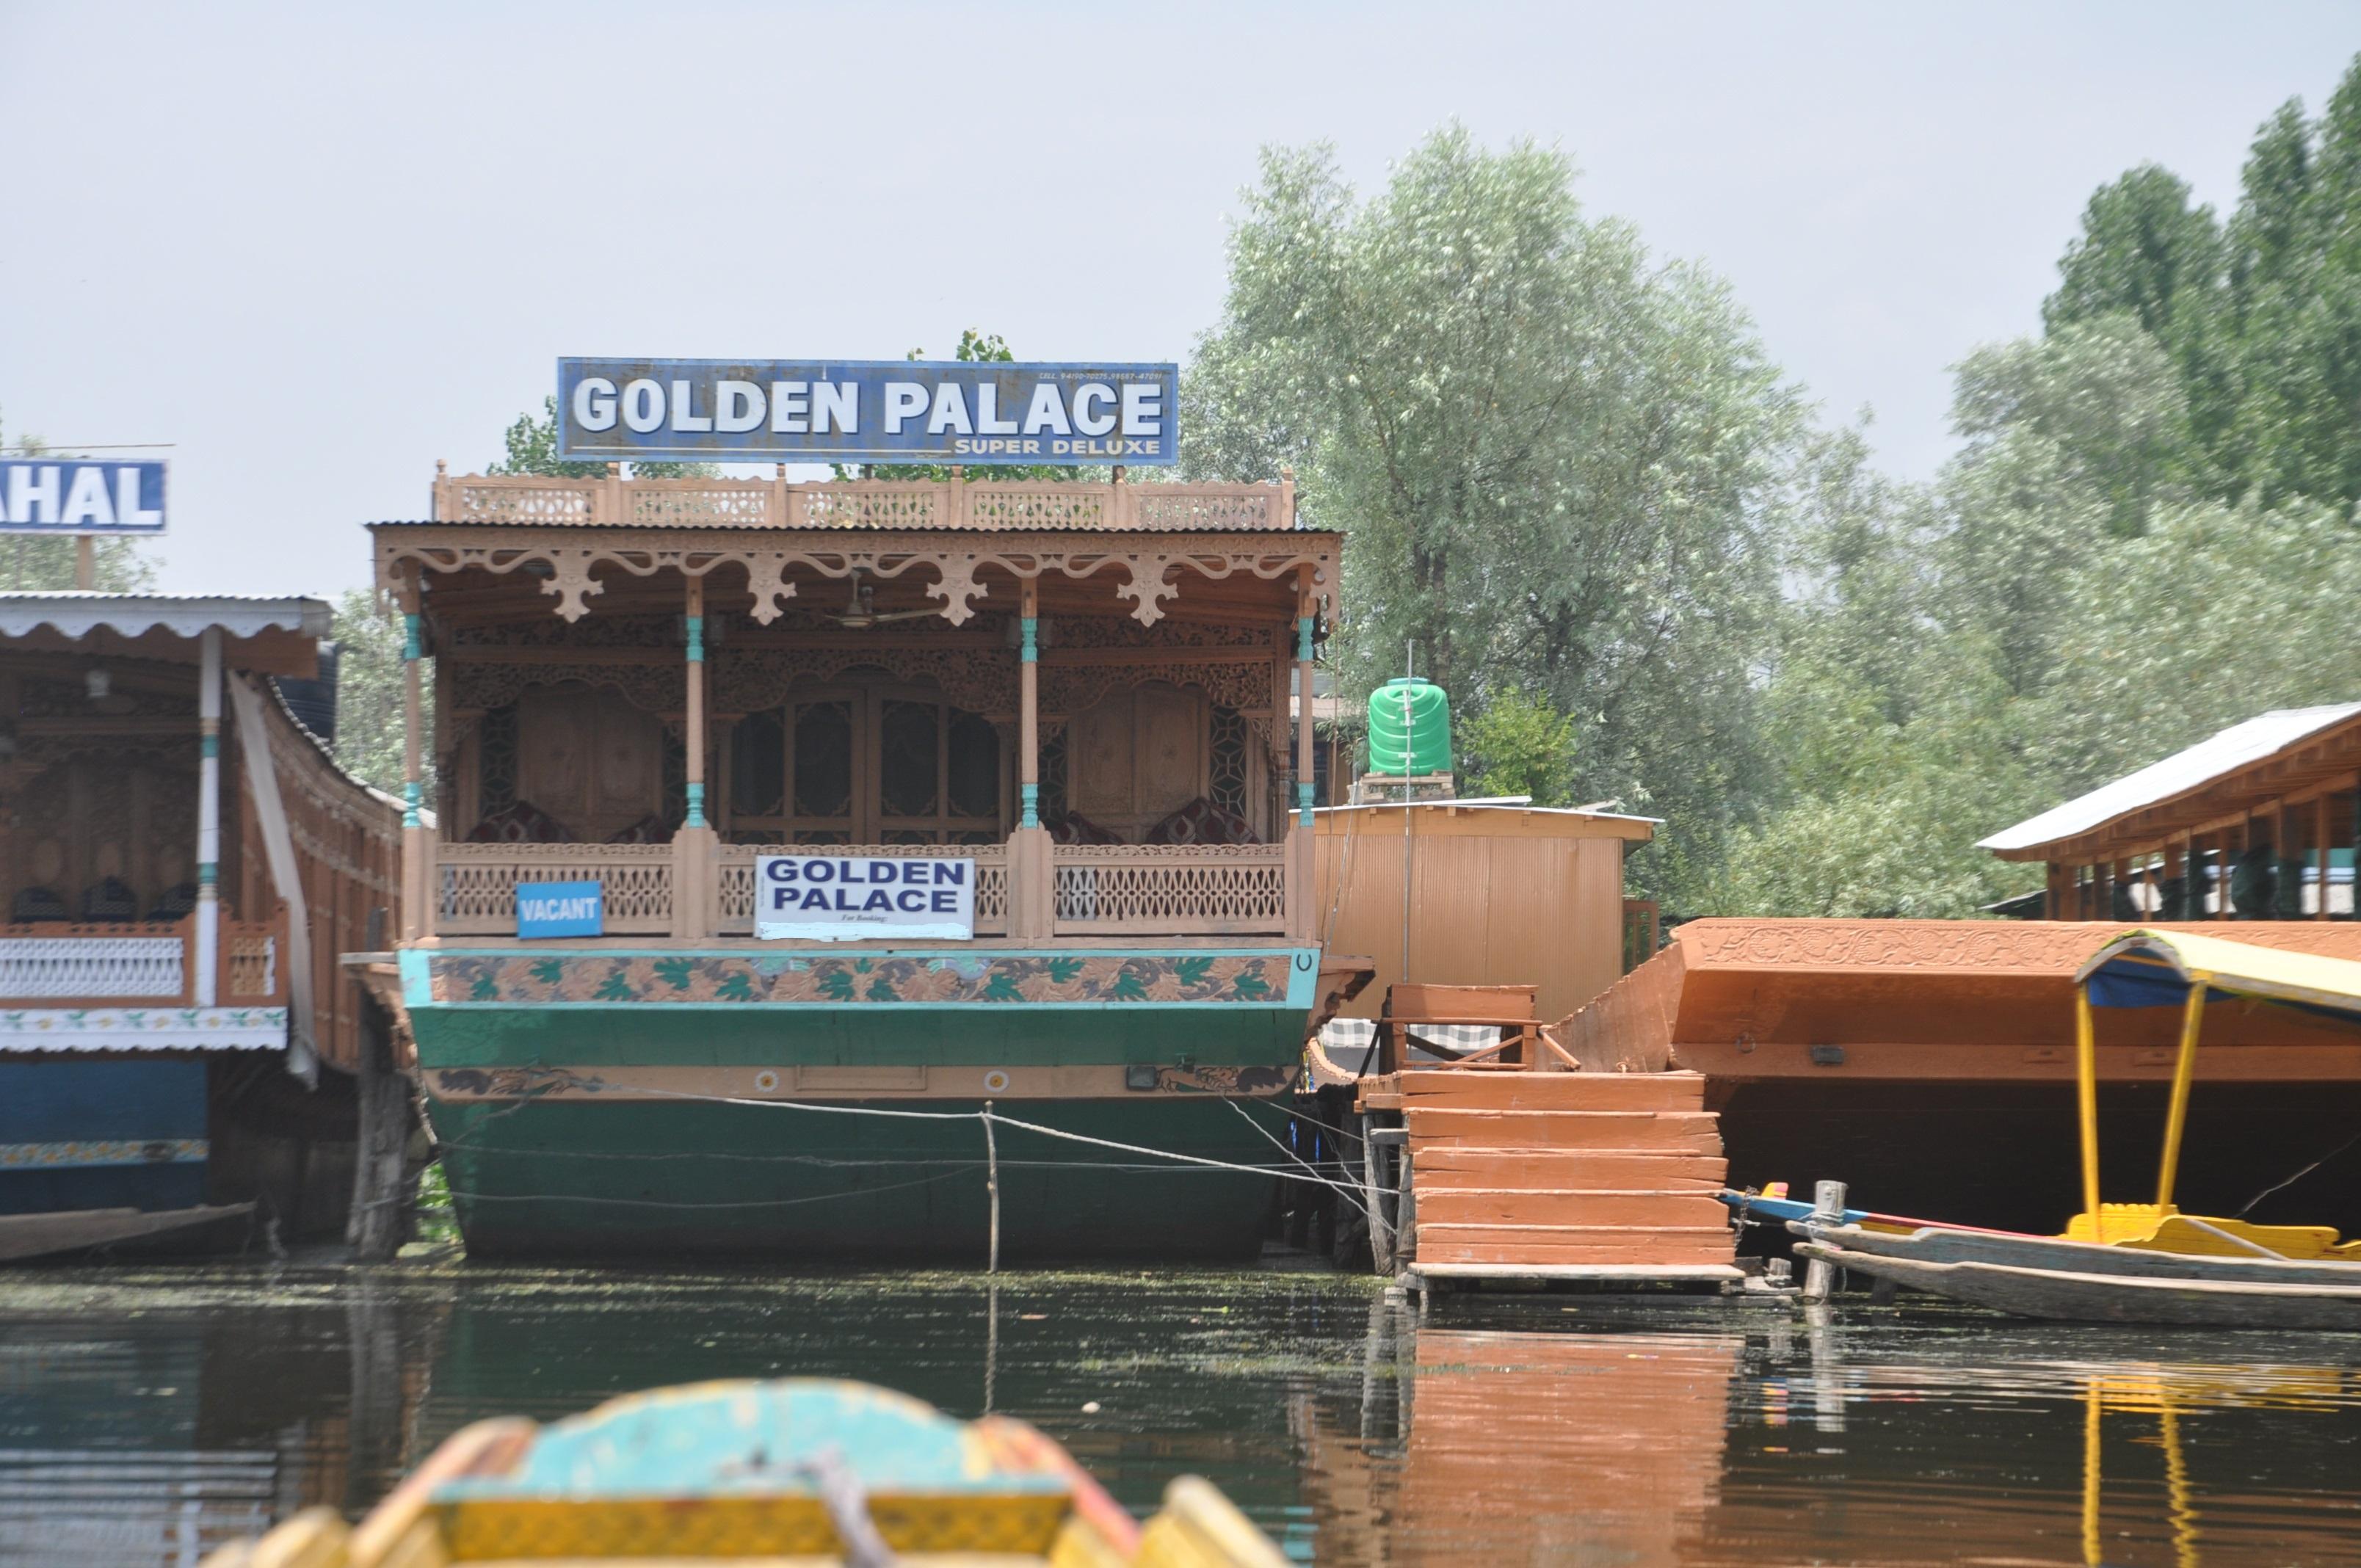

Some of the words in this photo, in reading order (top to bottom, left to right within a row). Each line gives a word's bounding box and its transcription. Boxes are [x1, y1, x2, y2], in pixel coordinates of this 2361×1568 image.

[573, 377, 858, 433] GOLDEN
[885, 382, 1162, 436] PALACE
[956, 440, 1040, 454] SUPER
[1053, 440, 1160, 455] DELUXE
[0, 465, 162, 524] HAL
[767, 860, 965, 885] GOLDEN
[520, 898, 598, 921] VACANT
[773, 888, 958, 912] PALACE
